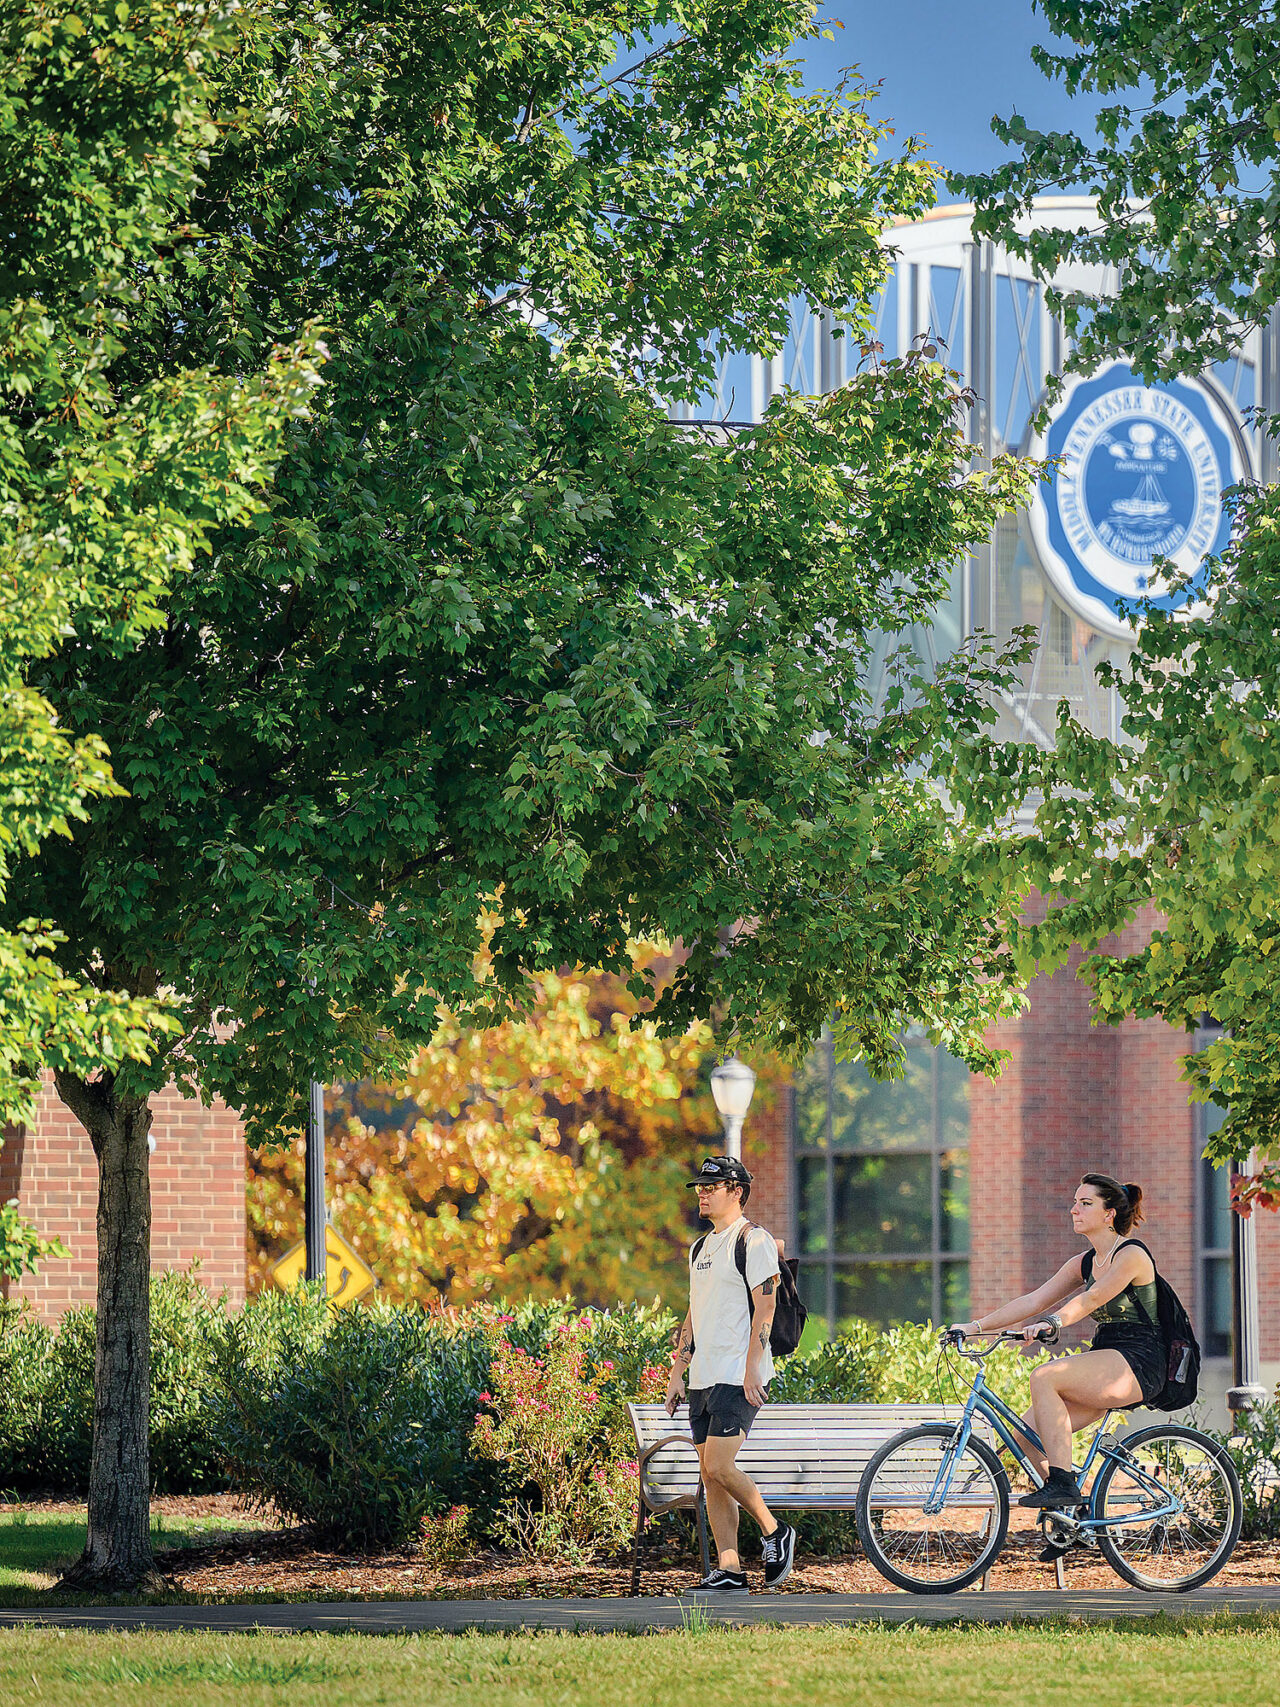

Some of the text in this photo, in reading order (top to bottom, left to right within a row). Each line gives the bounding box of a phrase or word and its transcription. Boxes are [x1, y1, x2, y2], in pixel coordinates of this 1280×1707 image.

[1065, 390, 1142, 465] TENNESSEE
[1151, 393, 1195, 438] STATE
[1186, 440, 1218, 559] UNIVERSITY
